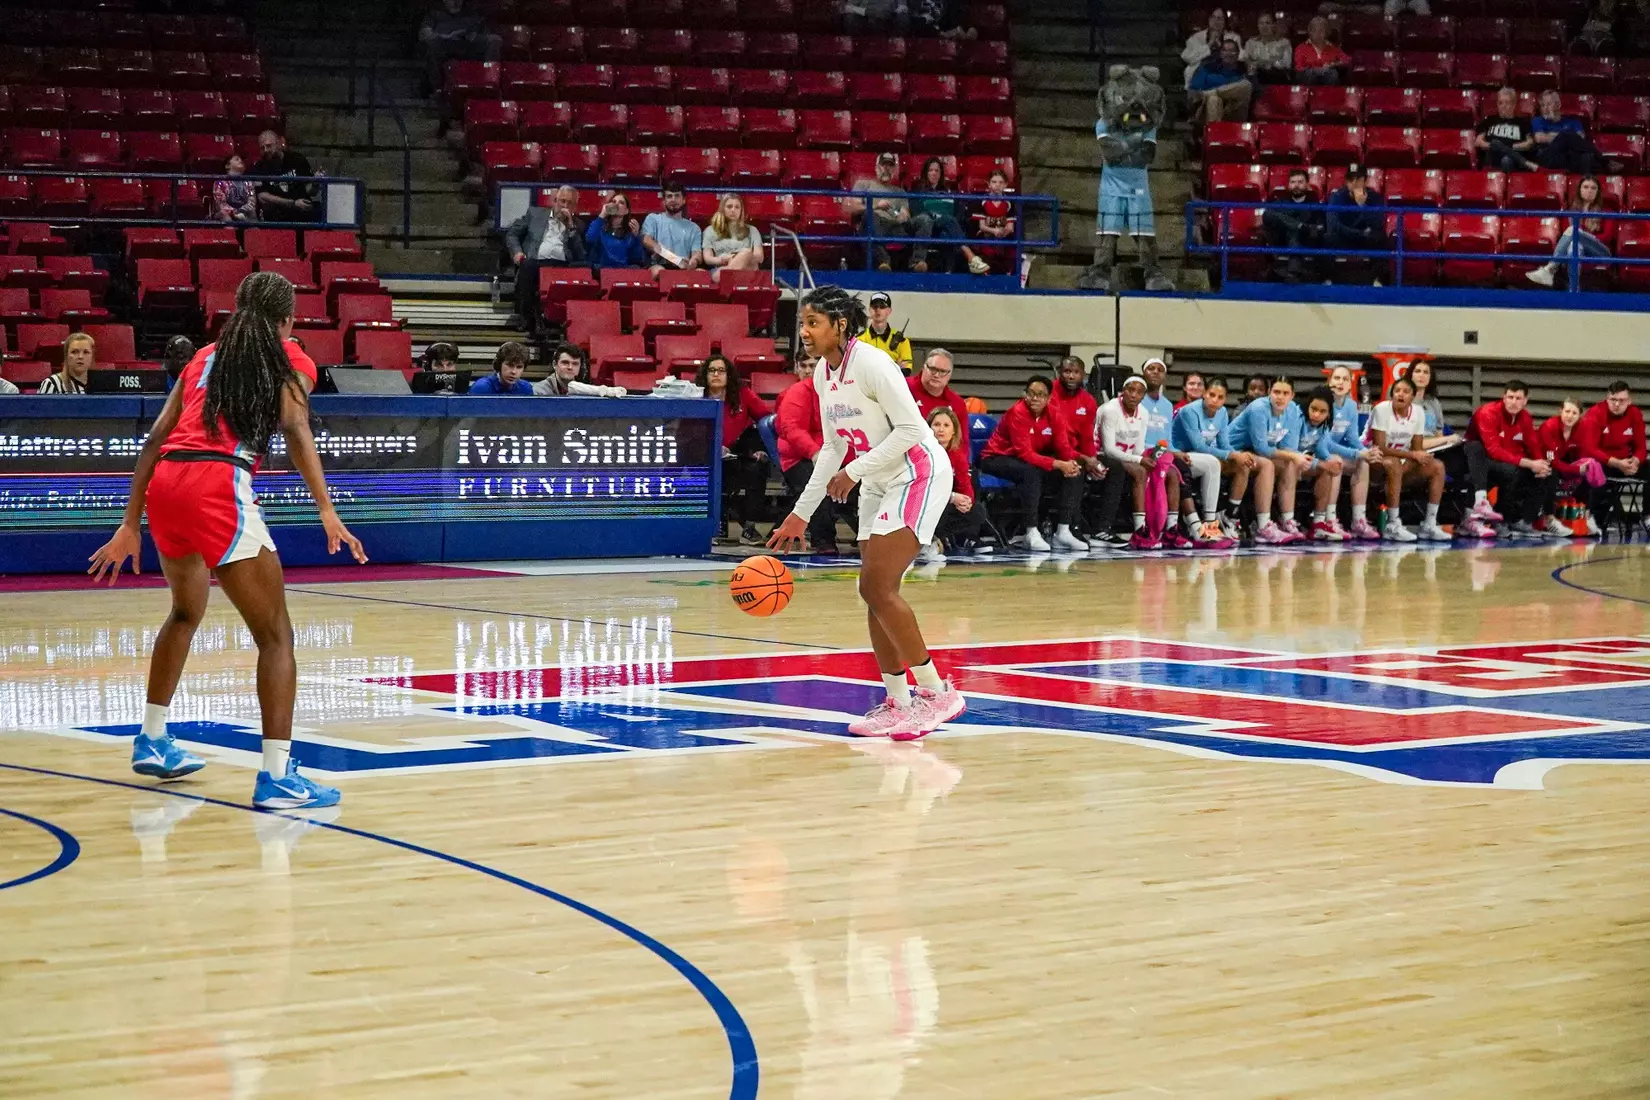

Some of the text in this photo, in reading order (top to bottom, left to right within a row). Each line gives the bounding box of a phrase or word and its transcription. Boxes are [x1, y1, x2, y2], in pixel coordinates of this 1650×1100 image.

[119, 375, 141, 388] POSS.
[457, 424, 678, 464] Ivan Smith
[458, 477, 676, 498] FURNITURE
